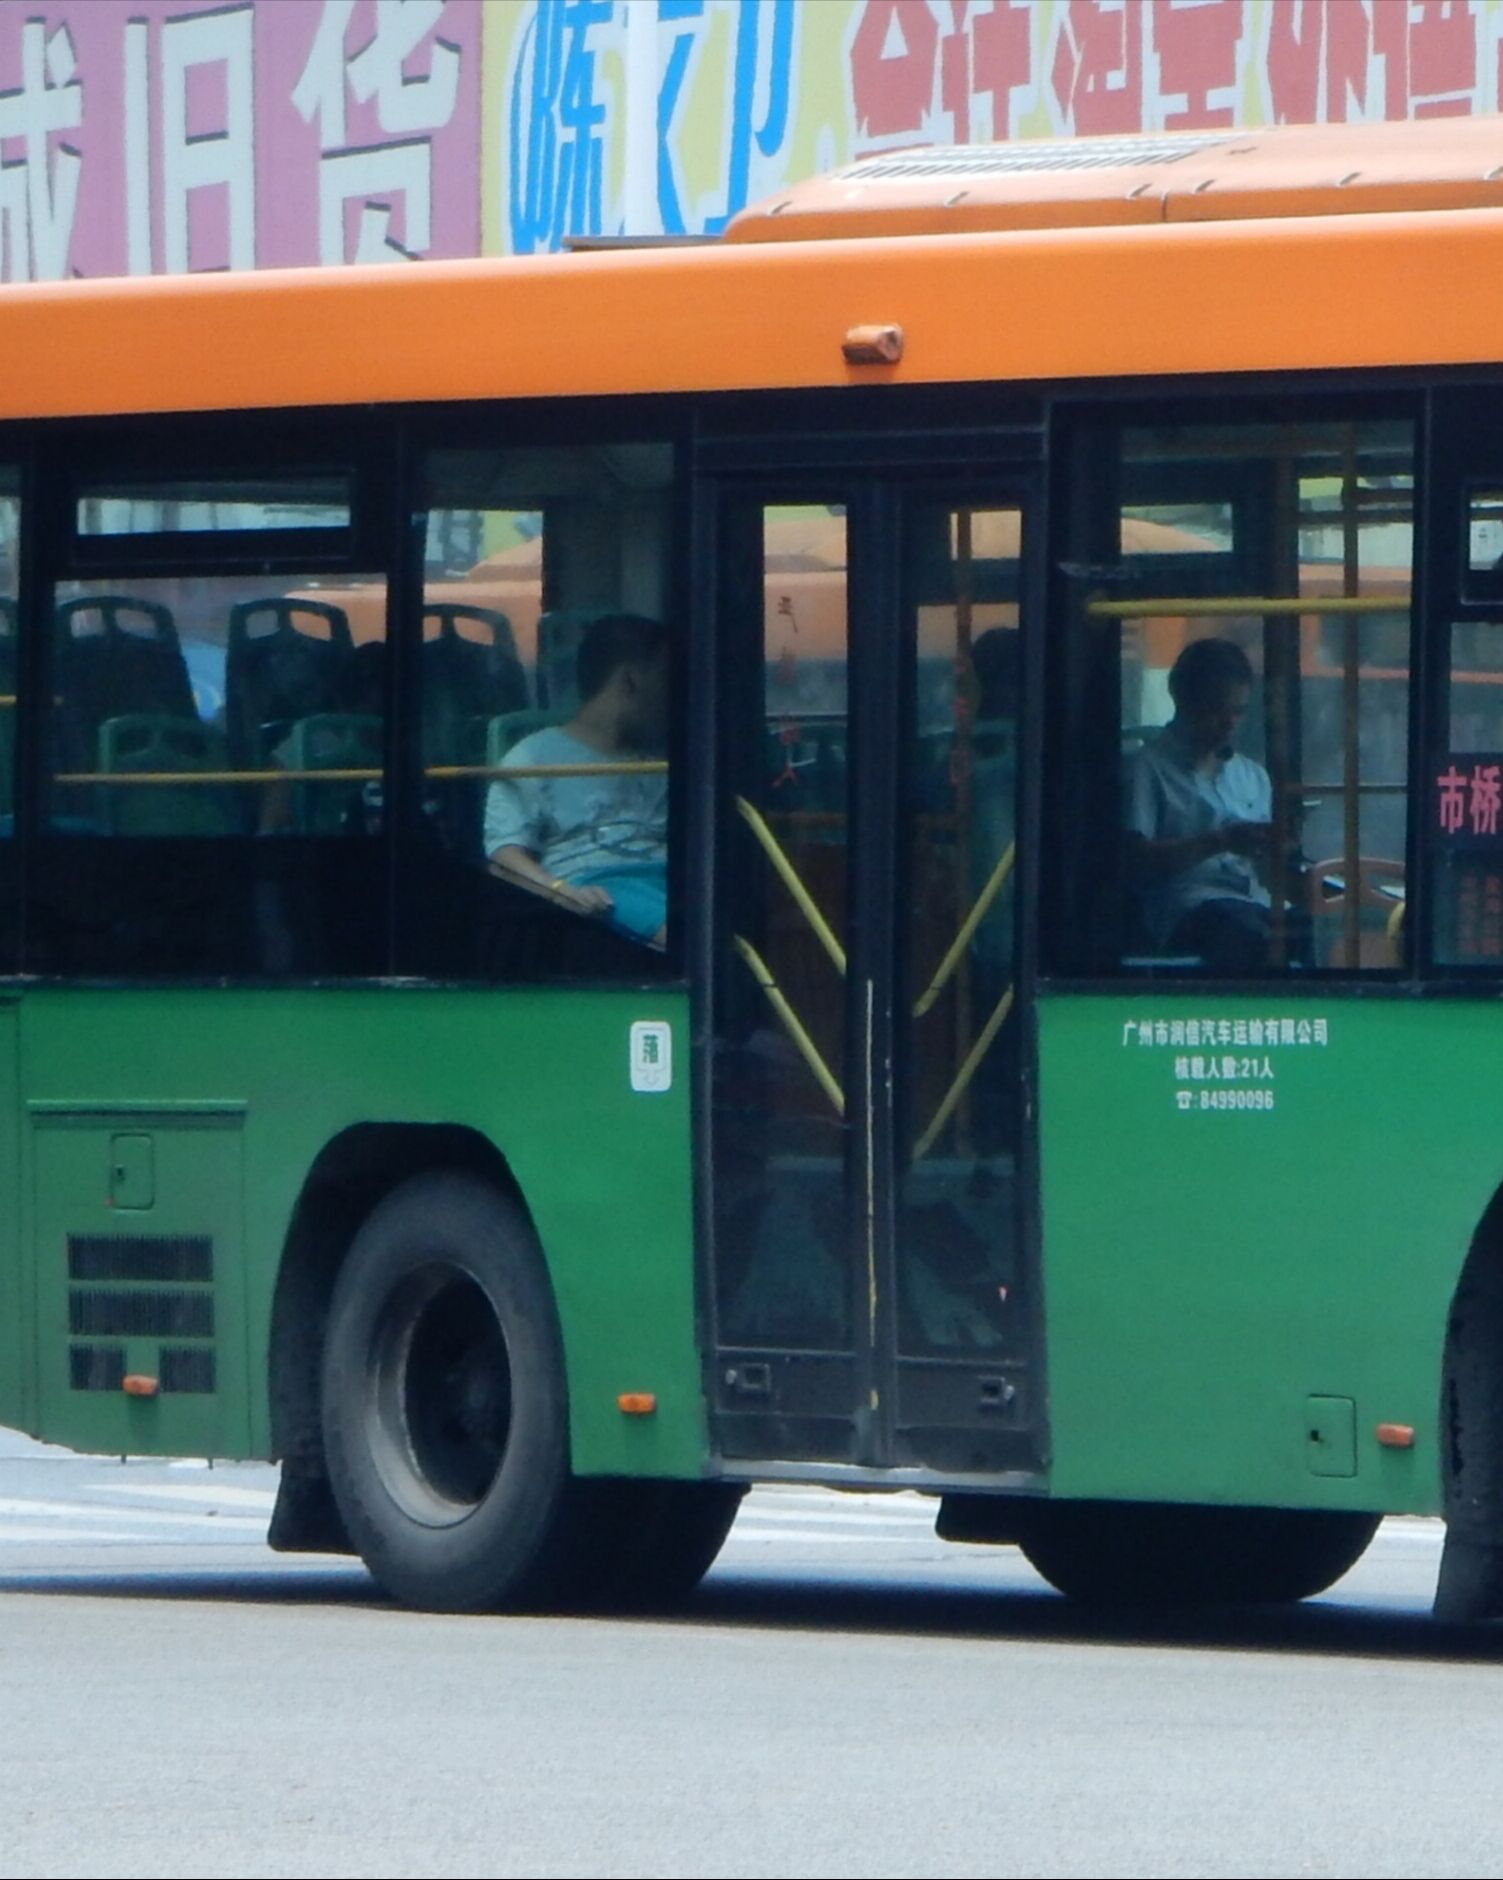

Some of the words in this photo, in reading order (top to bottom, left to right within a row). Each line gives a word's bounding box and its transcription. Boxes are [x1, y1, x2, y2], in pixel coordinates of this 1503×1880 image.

[1122, 1018, 1329, 1047] 广州市润信汽车运输有限公司
